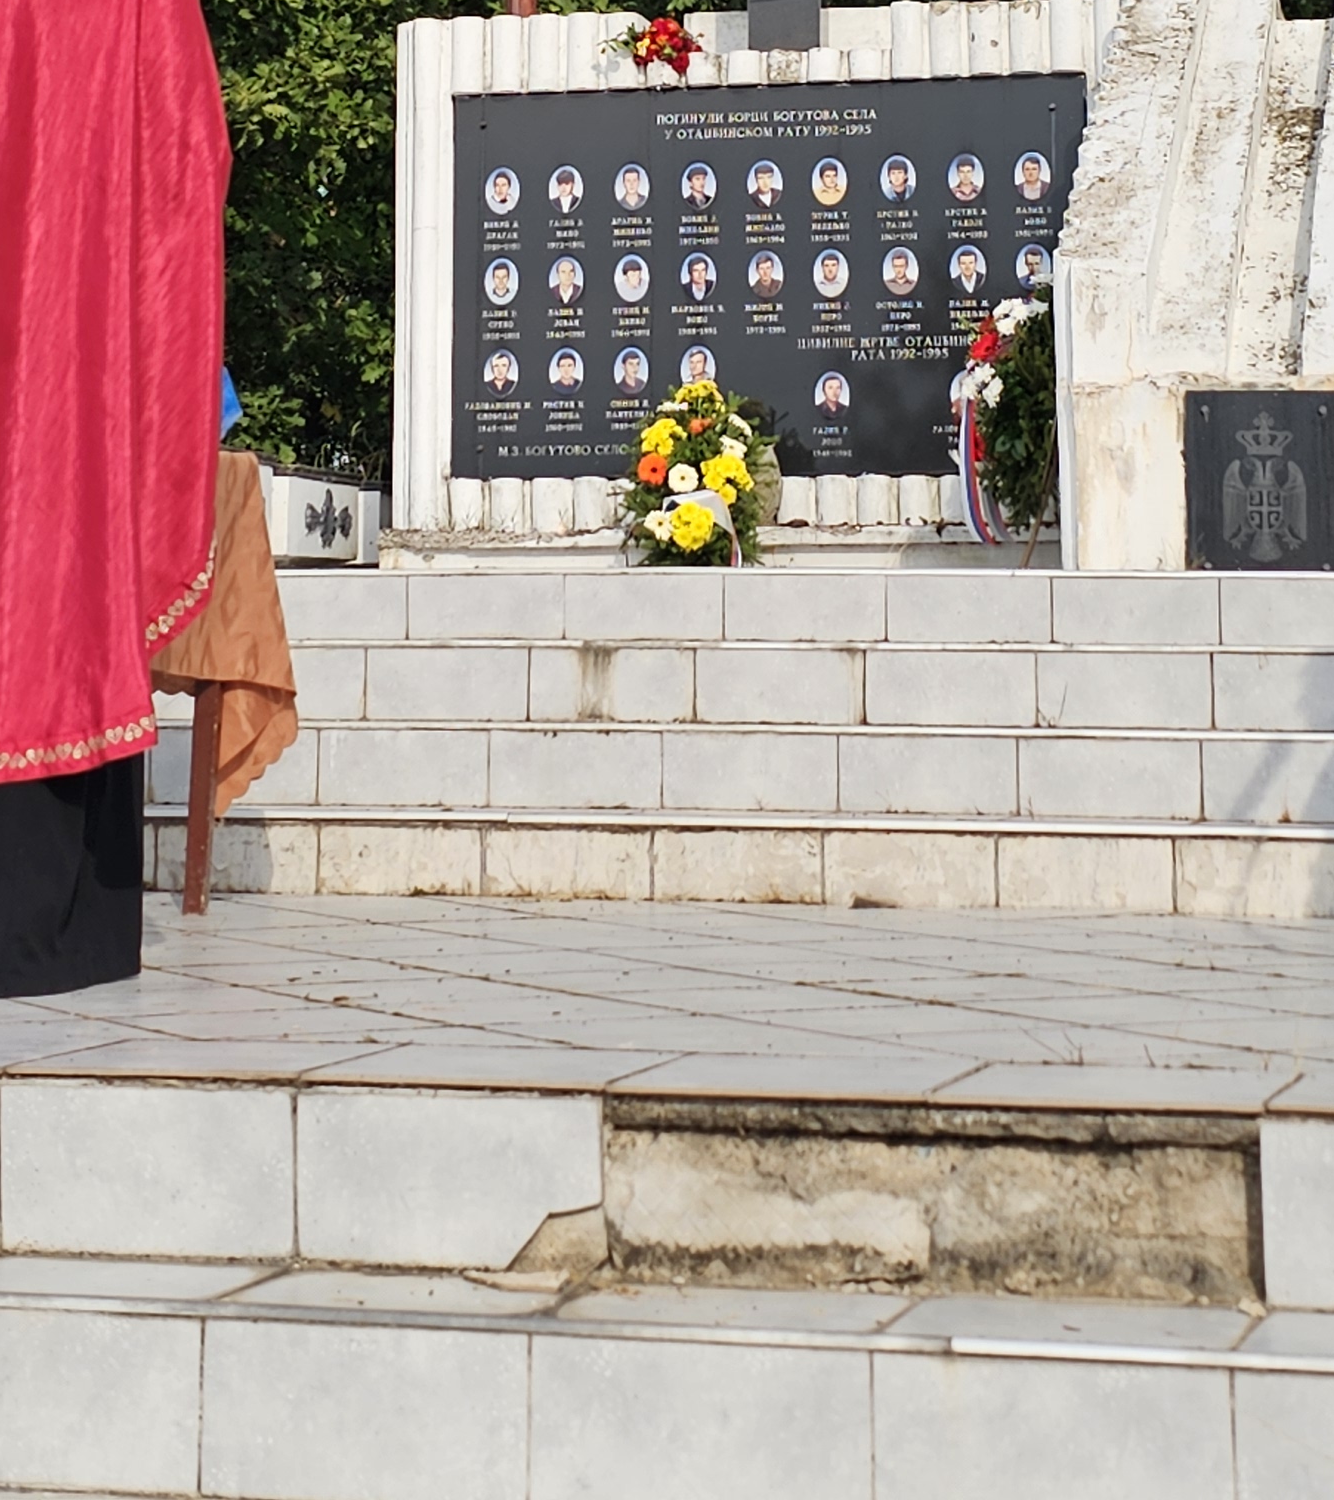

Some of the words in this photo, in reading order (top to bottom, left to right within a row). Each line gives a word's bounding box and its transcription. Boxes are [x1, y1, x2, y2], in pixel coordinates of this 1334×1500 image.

[657, 113, 723, 125] ПОГИНУЛИ
[728, 112, 768, 123] БОРЦИ
[774, 110, 839, 122] БОГУТОВА
[843, 109, 876, 119] СЕЛА
[665, 130, 673, 140] У
[676, 126, 773, 140] ОТАЏБИНСКОМ
[778, 126, 810, 137] РАТУ
[815, 124, 871, 136] 1992-1995
[797, 338, 856, 349] ЦИВИЛНЕ
[861, 337, 899, 350] ЖРТВЕ
[852, 350, 885, 361] РАТА
[891, 348, 948, 360] 1992-1995
[525, 445, 591, 456] БОГУТОВО
[595, 444, 628, 455] СЕЛО
